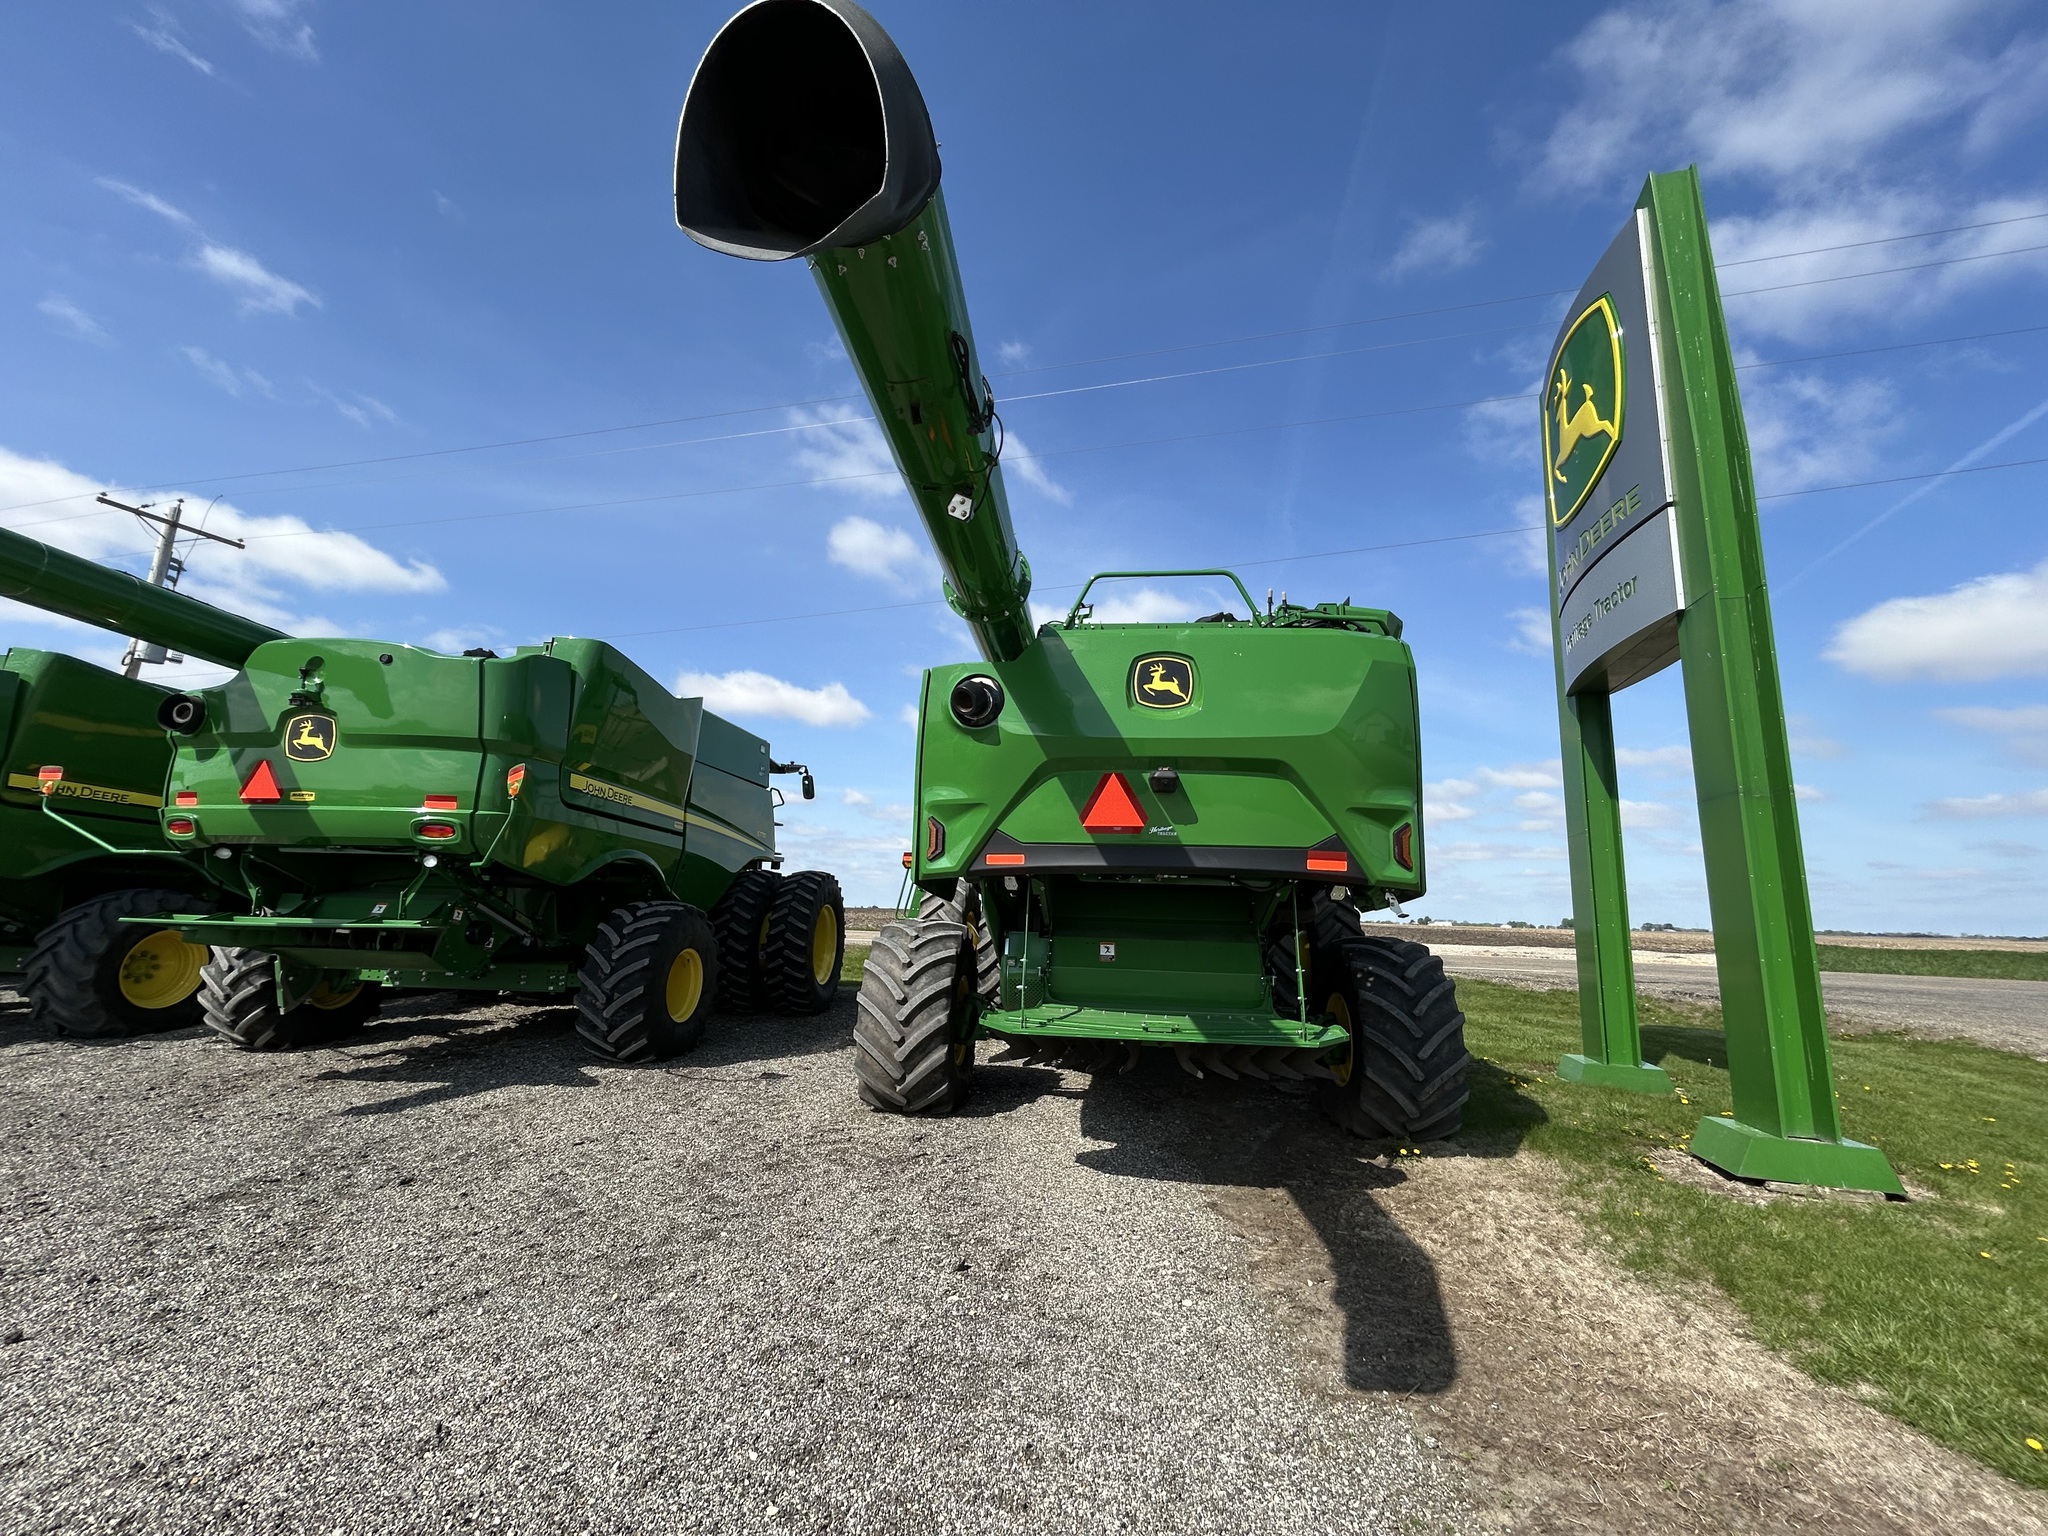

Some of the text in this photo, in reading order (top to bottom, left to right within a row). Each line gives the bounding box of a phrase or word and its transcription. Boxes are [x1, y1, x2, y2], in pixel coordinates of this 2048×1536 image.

[1559, 484, 1642, 597] JOHN DEERE
[1593, 576, 1637, 621] Tractor
[31, 784, 130, 803] HN DEERE
[582, 781, 633, 805] JOHN DEERE
